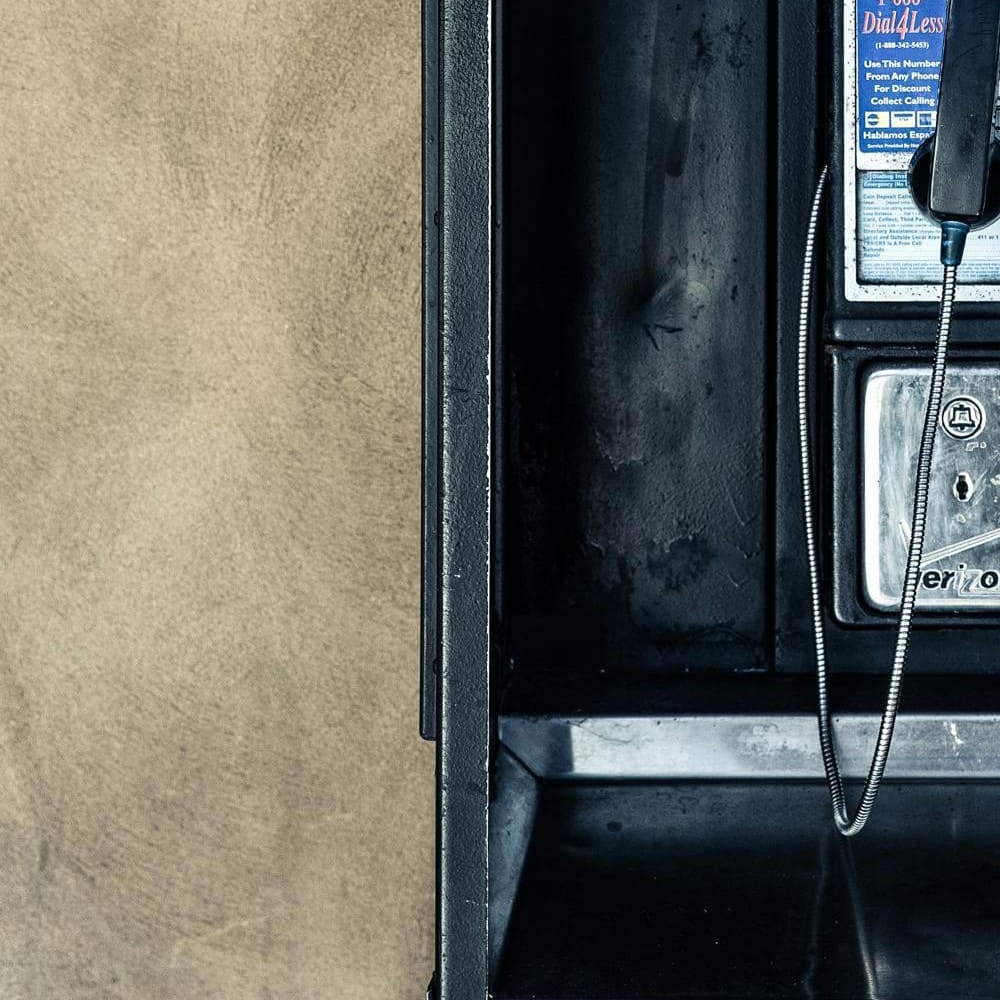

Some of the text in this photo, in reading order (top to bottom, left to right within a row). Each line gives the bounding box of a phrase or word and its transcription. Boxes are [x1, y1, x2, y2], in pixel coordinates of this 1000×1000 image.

[861, 6, 944, 40] Dial4Less
[875, 41, 930, 49] (1-888-342-5453)
[864, 60, 940, 68] Use This Number
[866, 72, 939, 82] From Any Phone
[874, 85, 931, 93] For Discount
[870, 97, 935, 106] Collect Calling
[863, 131, 908, 140] Hablamos
